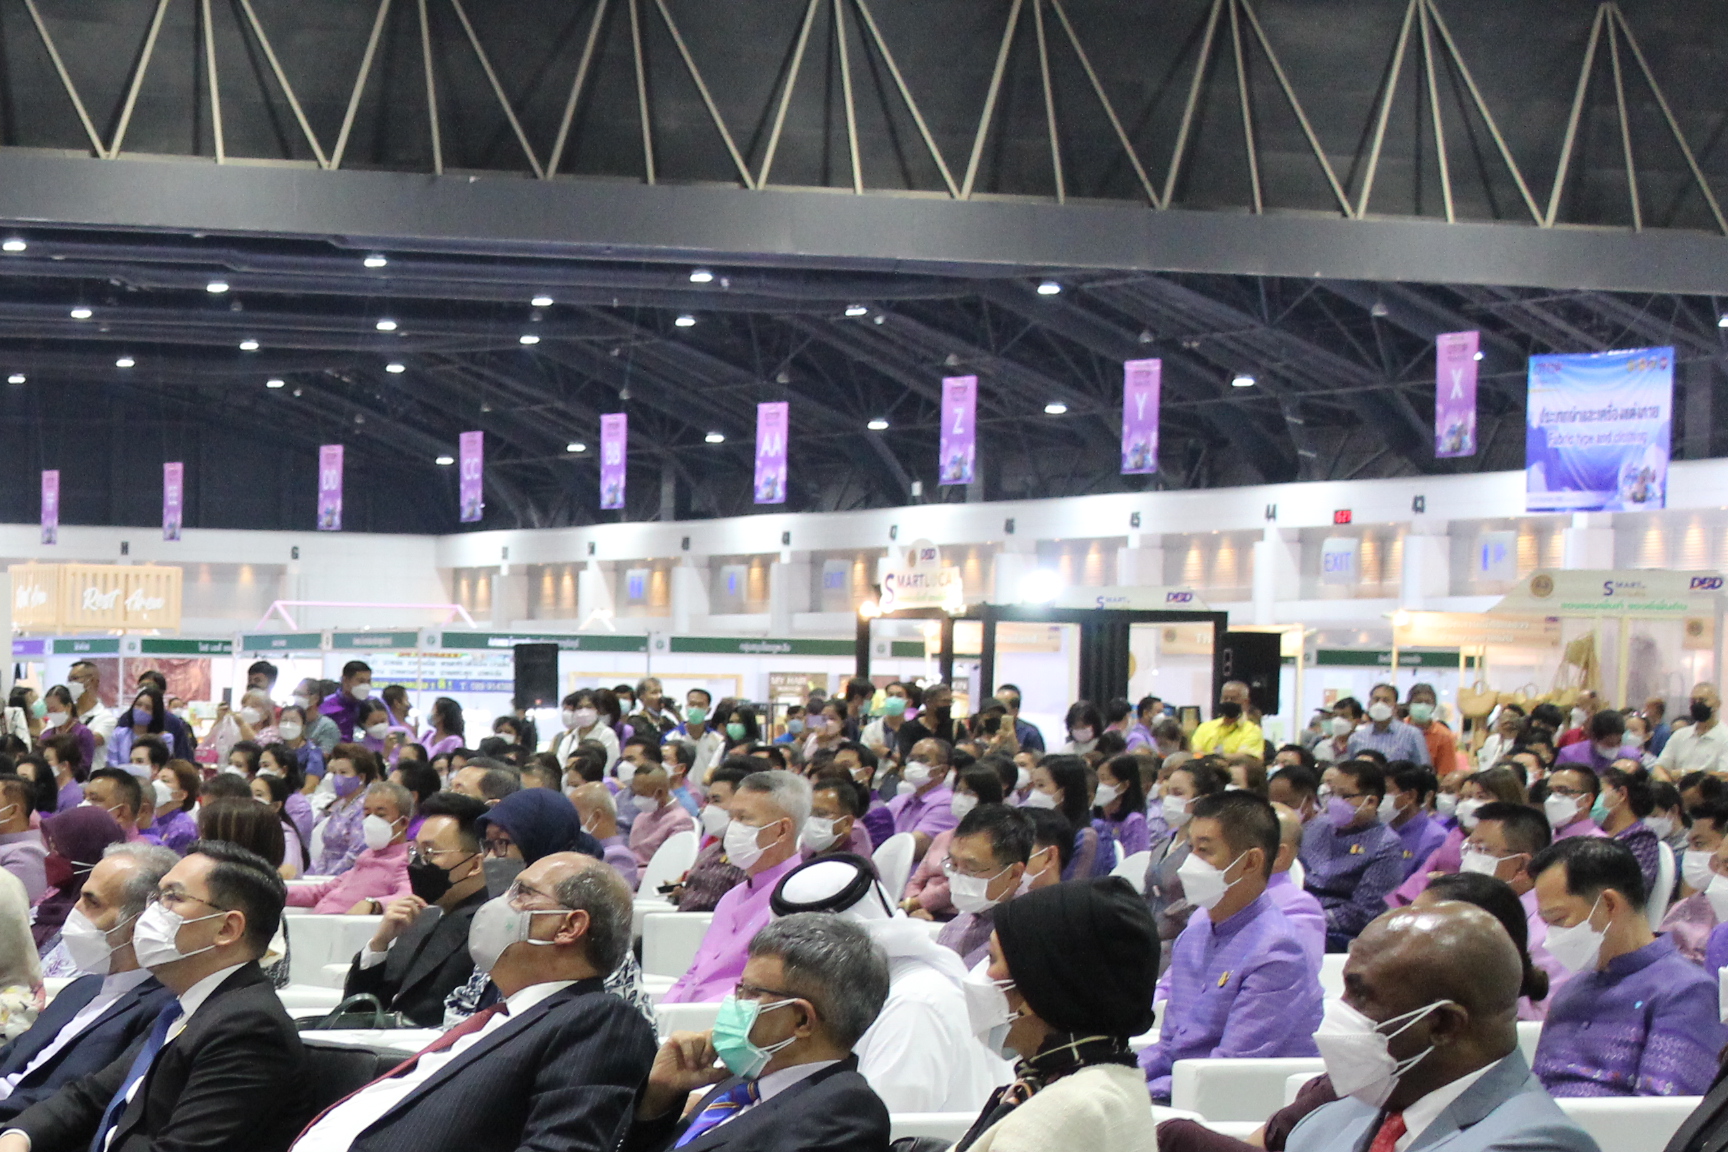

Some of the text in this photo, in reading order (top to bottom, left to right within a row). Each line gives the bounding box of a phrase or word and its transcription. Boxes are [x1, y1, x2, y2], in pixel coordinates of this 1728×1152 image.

[1450, 369, 1464, 400] X
[1134, 392, 1147, 421] Y
[952, 407, 965, 434] Z
[605, 442, 620, 466] BB
[759, 433, 783, 457] AA
[464, 458, 480, 480] CC
[1325, 551, 1352, 571] EXIT
[82, 588, 165, 611] Rest Area
